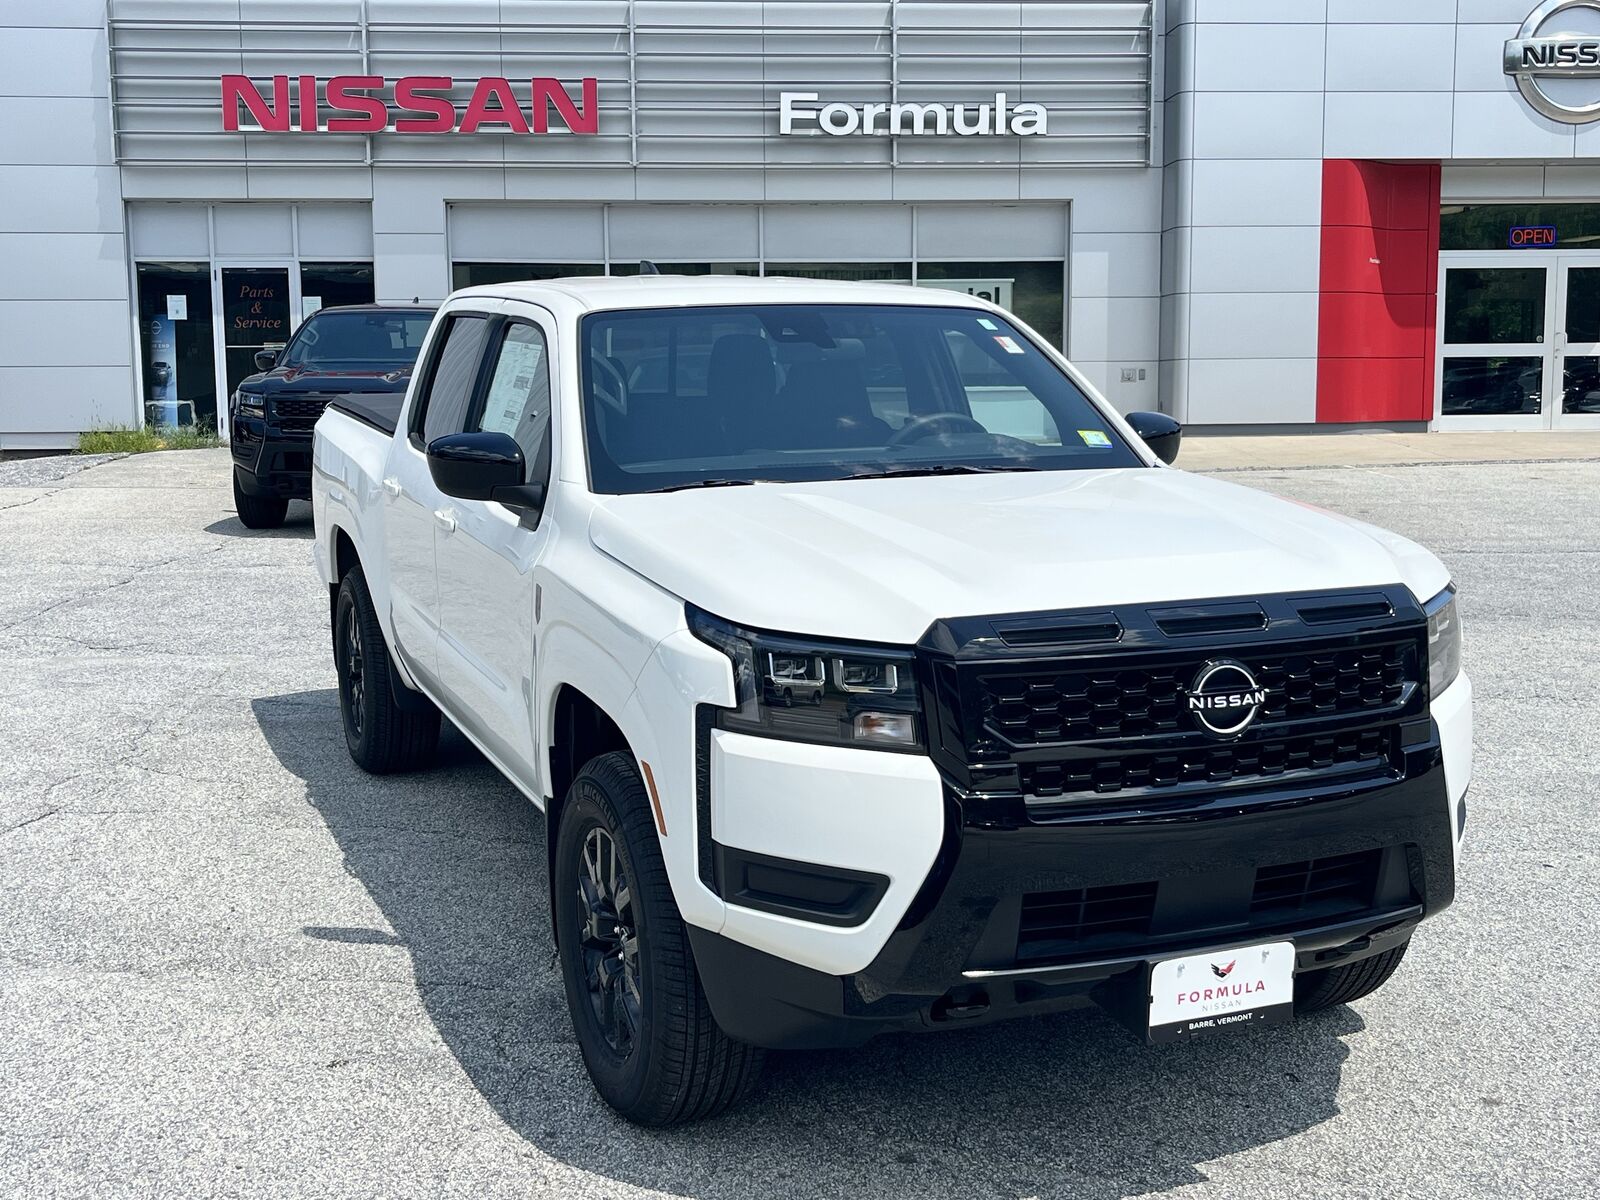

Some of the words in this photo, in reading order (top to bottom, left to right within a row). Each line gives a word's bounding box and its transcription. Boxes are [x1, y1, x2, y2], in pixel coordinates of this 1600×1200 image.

[1521, 43, 1600, 67] NISS
[221, 74, 598, 135] NISSAN
[779, 91, 1048, 136] Formula
[1511, 229, 1553, 245] OPEN
[240, 285, 274, 298] Parts
[251, 301, 262, 314] &
[234, 316, 281, 329] Service
[1189, 690, 1265, 709] NISSAN
[583, 783, 617, 828] MICHELIN
[1177, 980, 1266, 1005] FORMULA
[1201, 999, 1242, 1012] NISSAN
[1188, 1019, 1216, 1031] BARRE,
[1217, 1012, 1253, 1026] VERMONT
